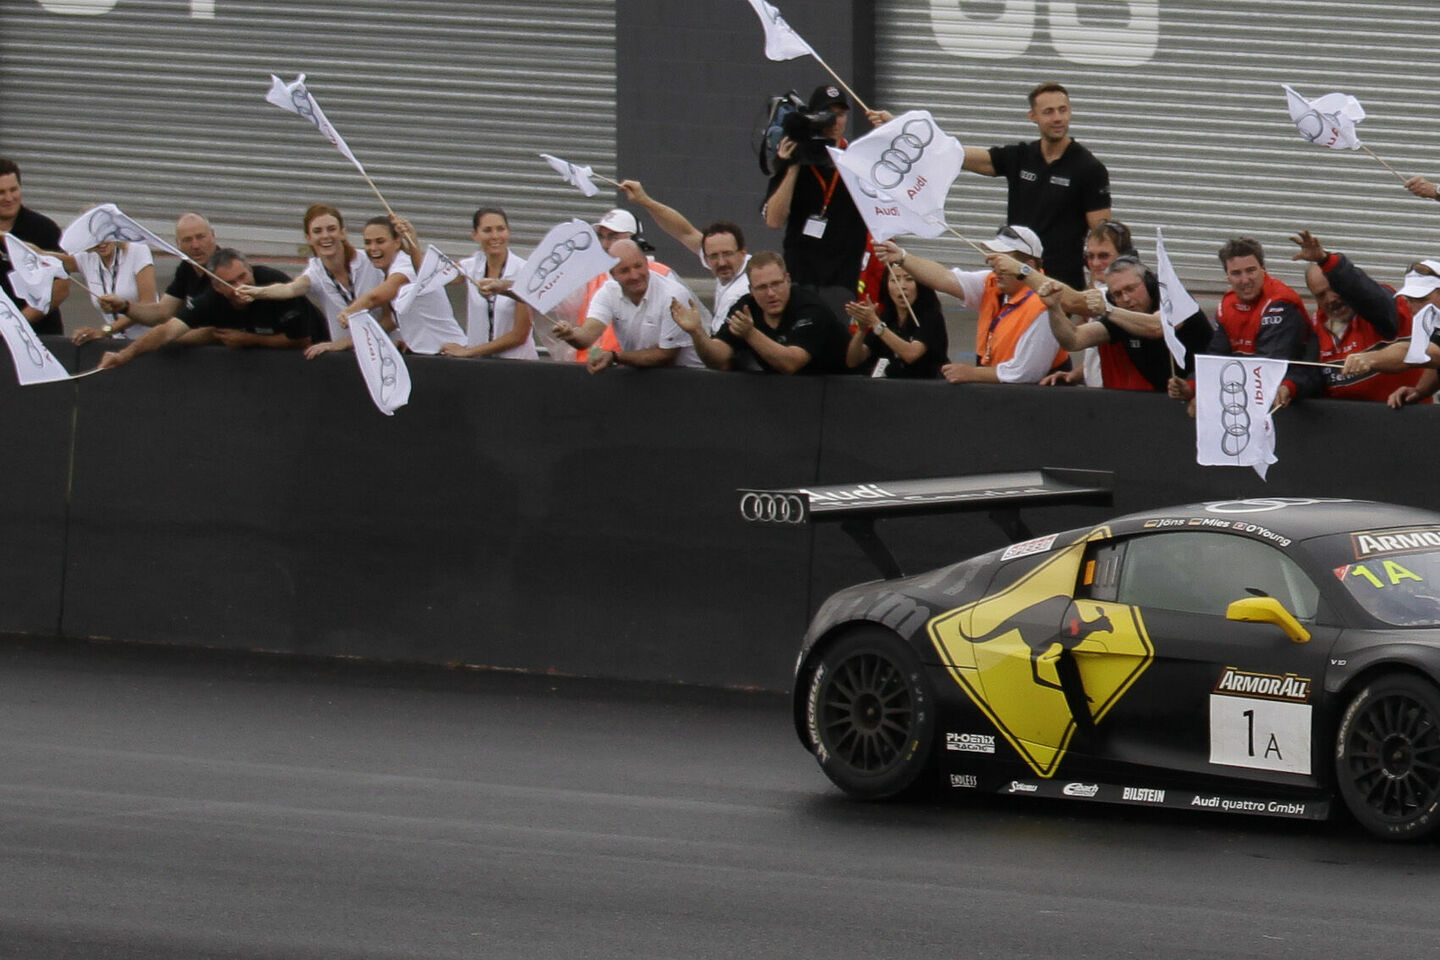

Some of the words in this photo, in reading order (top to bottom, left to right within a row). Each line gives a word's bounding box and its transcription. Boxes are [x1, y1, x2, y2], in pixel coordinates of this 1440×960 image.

[907, 176, 928, 200] Audi
[800, 484, 896, 502] Audi
[1157, 518, 1185, 527] Jöns
[1202, 518, 1230, 528] Mies
[1245, 524, 1292, 547] O'Young
[1122, 787, 1166, 802] BILSTEIN
[1191, 796, 1219, 807] Audi
[1221, 799, 1265, 811] quattro
[1267, 802, 1305, 814] GmbH
